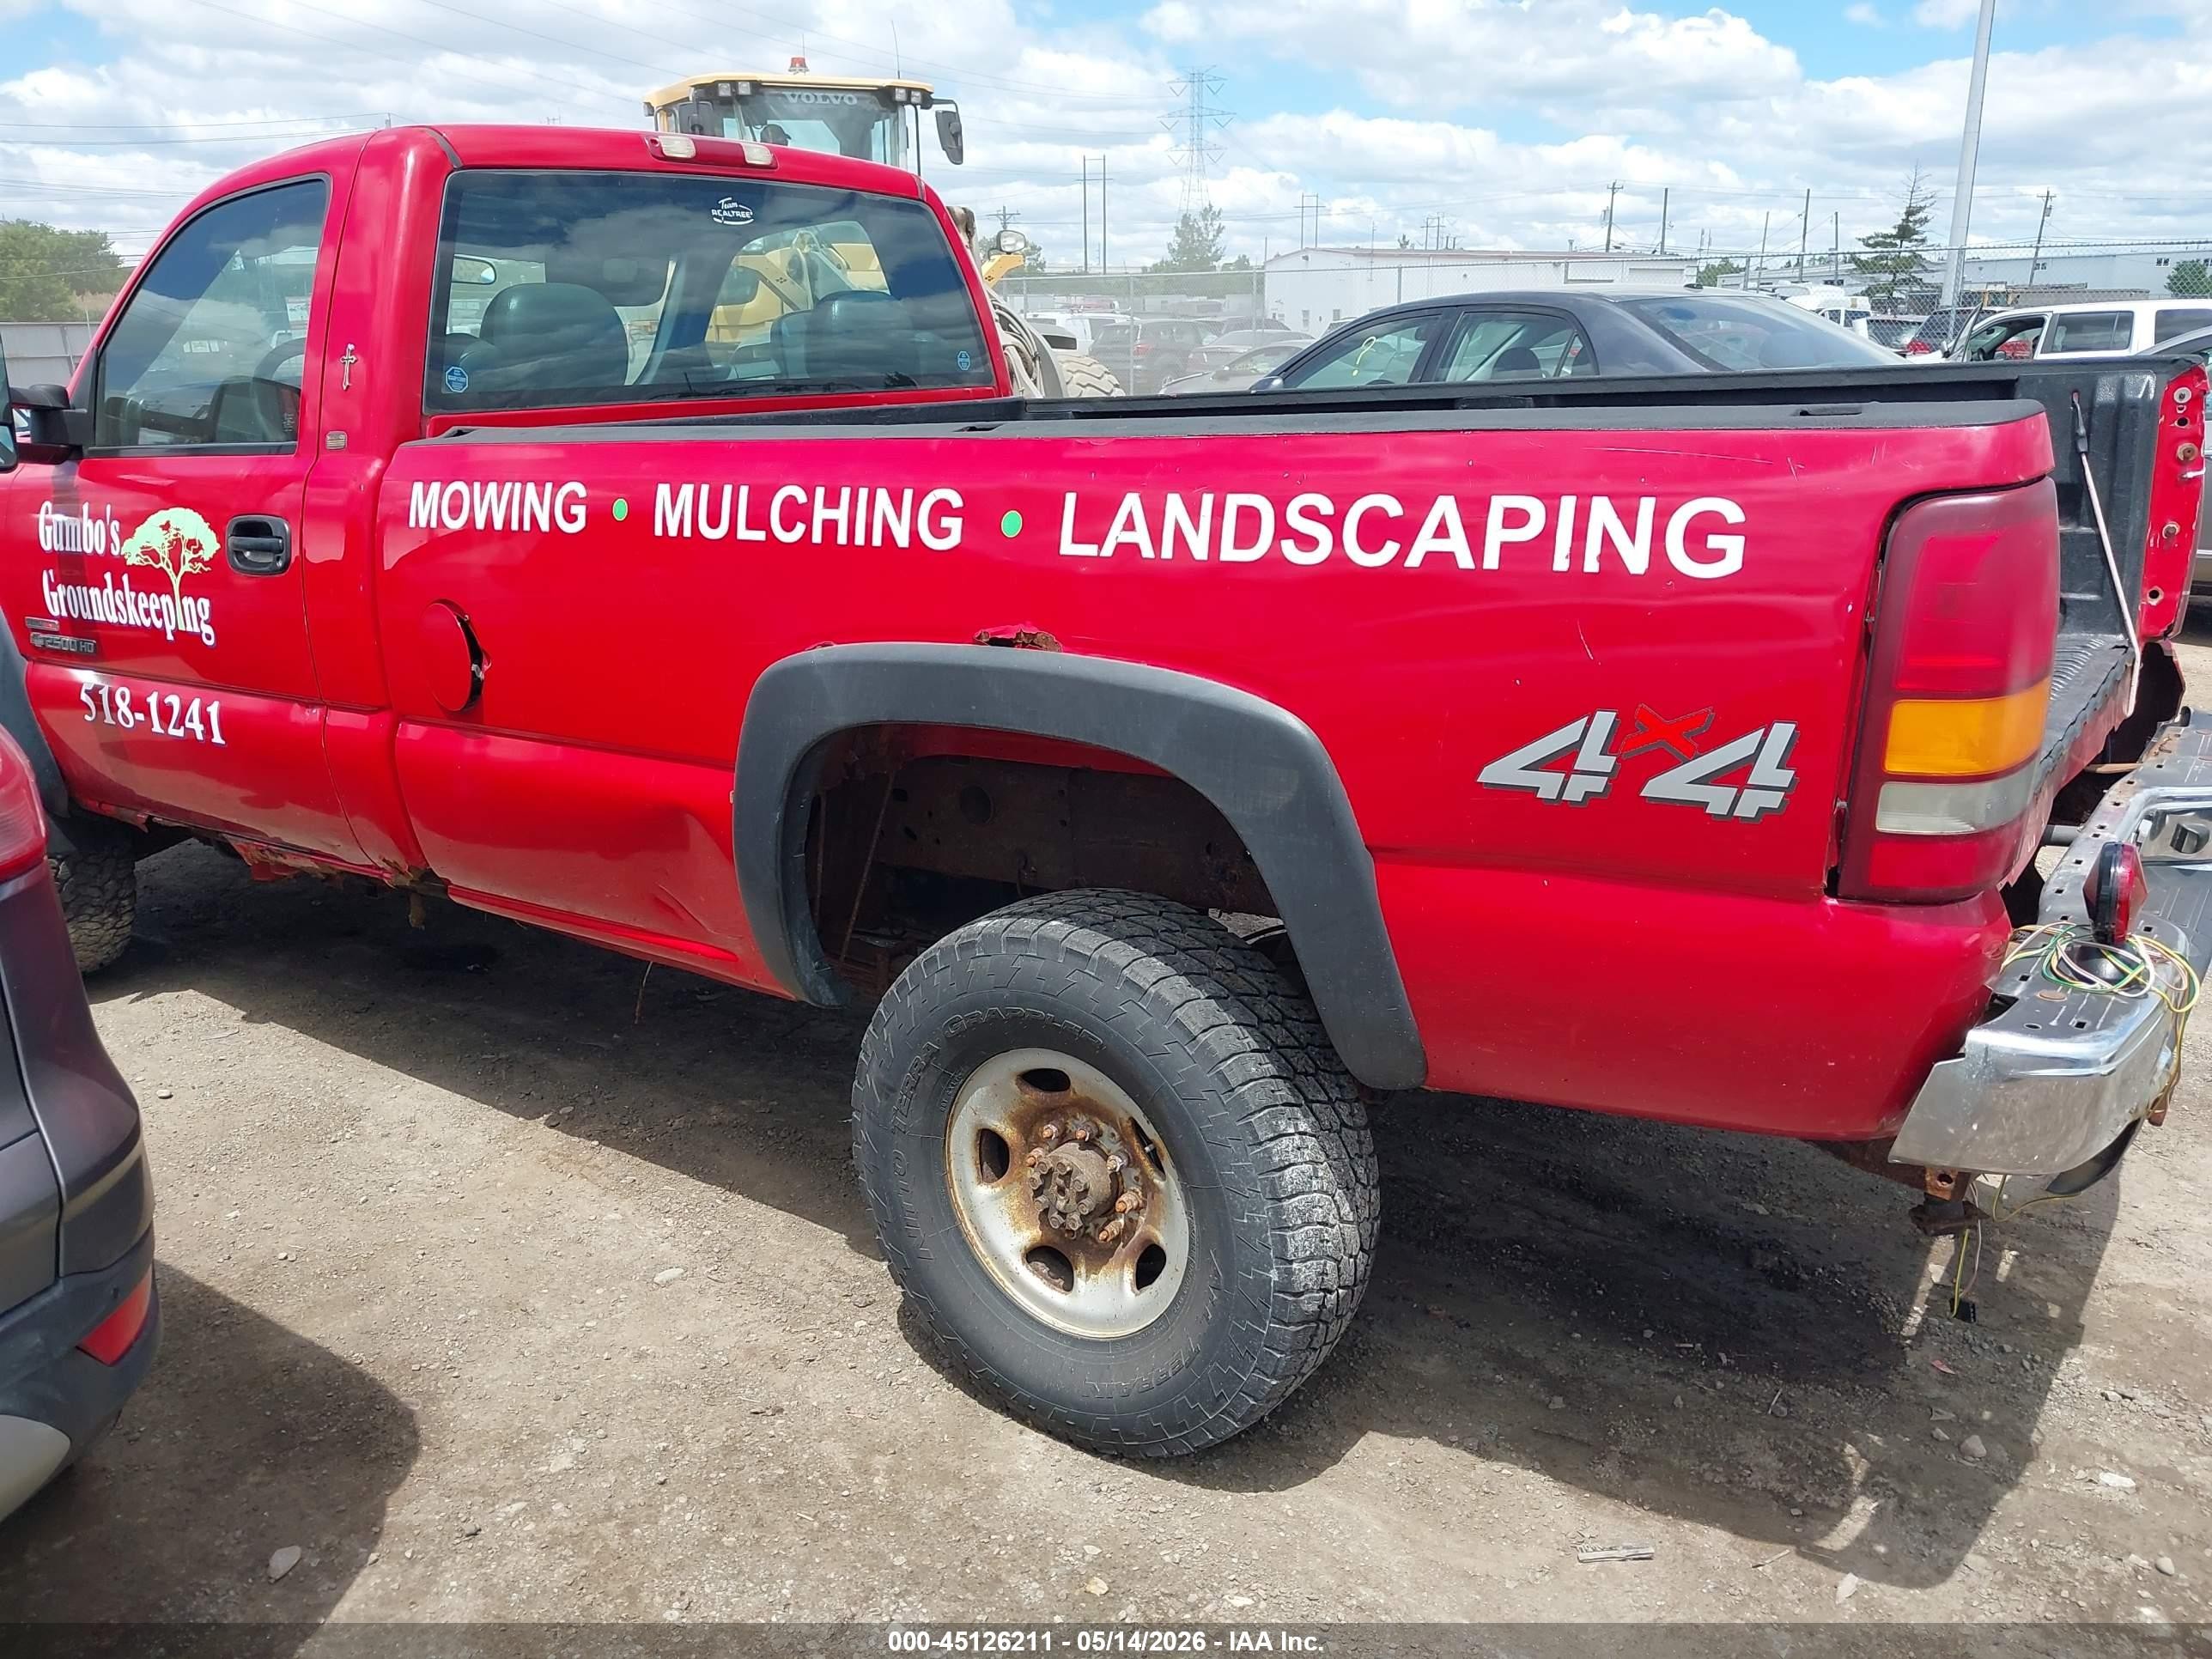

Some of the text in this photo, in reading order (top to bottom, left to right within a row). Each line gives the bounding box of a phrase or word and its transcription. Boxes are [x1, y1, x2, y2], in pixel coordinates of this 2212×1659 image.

[782, 92, 857, 105] VOLVO
[718, 197, 738, 209] Team
[38, 500, 121, 556] Gumbo's
[408, 480, 1747, 580] MOWING MULCHING LANDSCAPING
[42, 569, 216, 647] Groundskeeping
[79, 681, 227, 745] 518-1241
